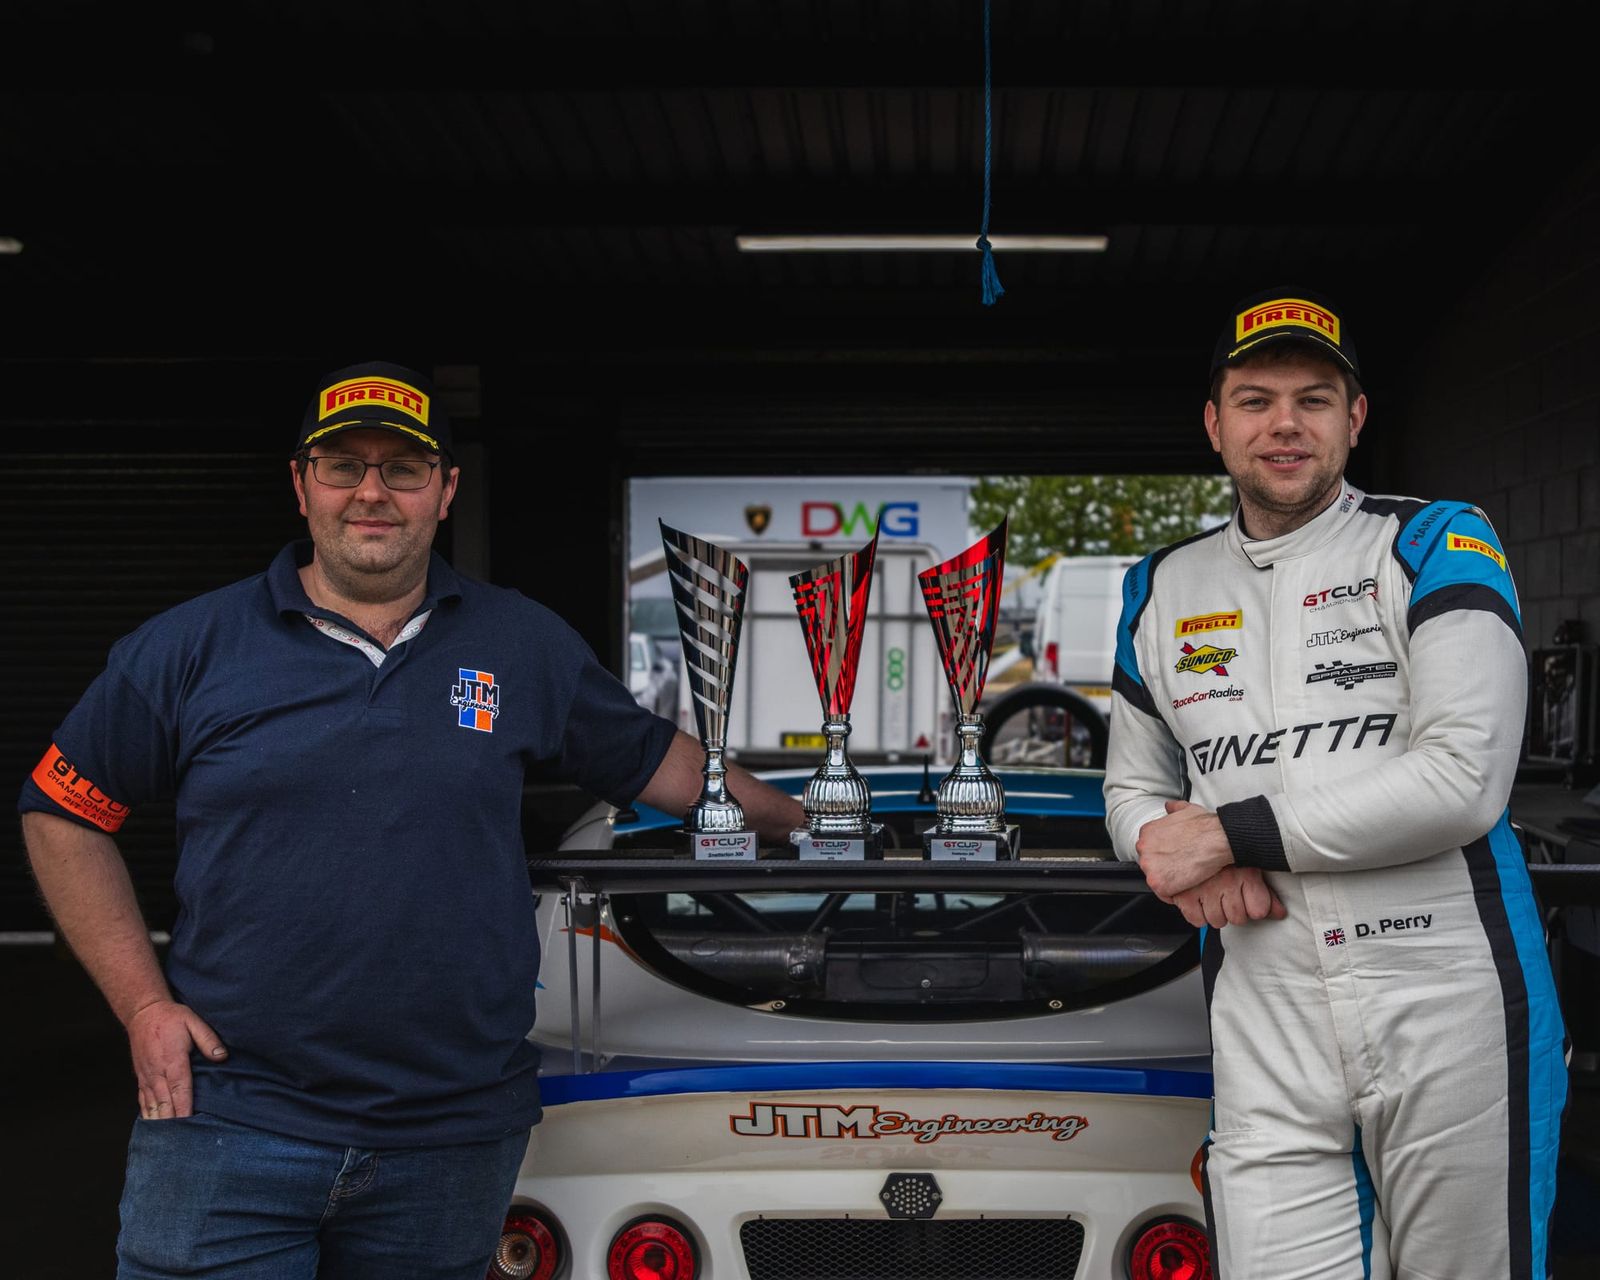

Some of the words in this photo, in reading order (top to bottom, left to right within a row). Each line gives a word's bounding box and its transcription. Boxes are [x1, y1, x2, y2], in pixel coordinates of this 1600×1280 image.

[1244, 302, 1334, 334] PIRELLI
[326, 381, 423, 415] PIRELLI
[802, 501, 918, 537] DWG
[1409, 507, 1448, 546] MARINA
[1181, 614, 1237, 633] PIRELLI
[1306, 629, 1342, 648] JTM
[1341, 624, 1384, 641] Engineerin
[1179, 651, 1234, 670] SUNOCO
[452, 678, 499, 706] JTM
[1190, 713, 1398, 775] GINETTA
[62, 795, 82, 809] PIT
[83, 808, 112, 828] LANE
[701, 837, 750, 848] GTCUP
[812, 841, 849, 849] GTCUP
[944, 841, 981, 849] GTCUP
[1355, 923, 1376, 938] D.
[1379, 914, 1432, 933] Perry
[730, 1102, 880, 1139] JTM
[872, 1112, 1089, 1143] Engineering
